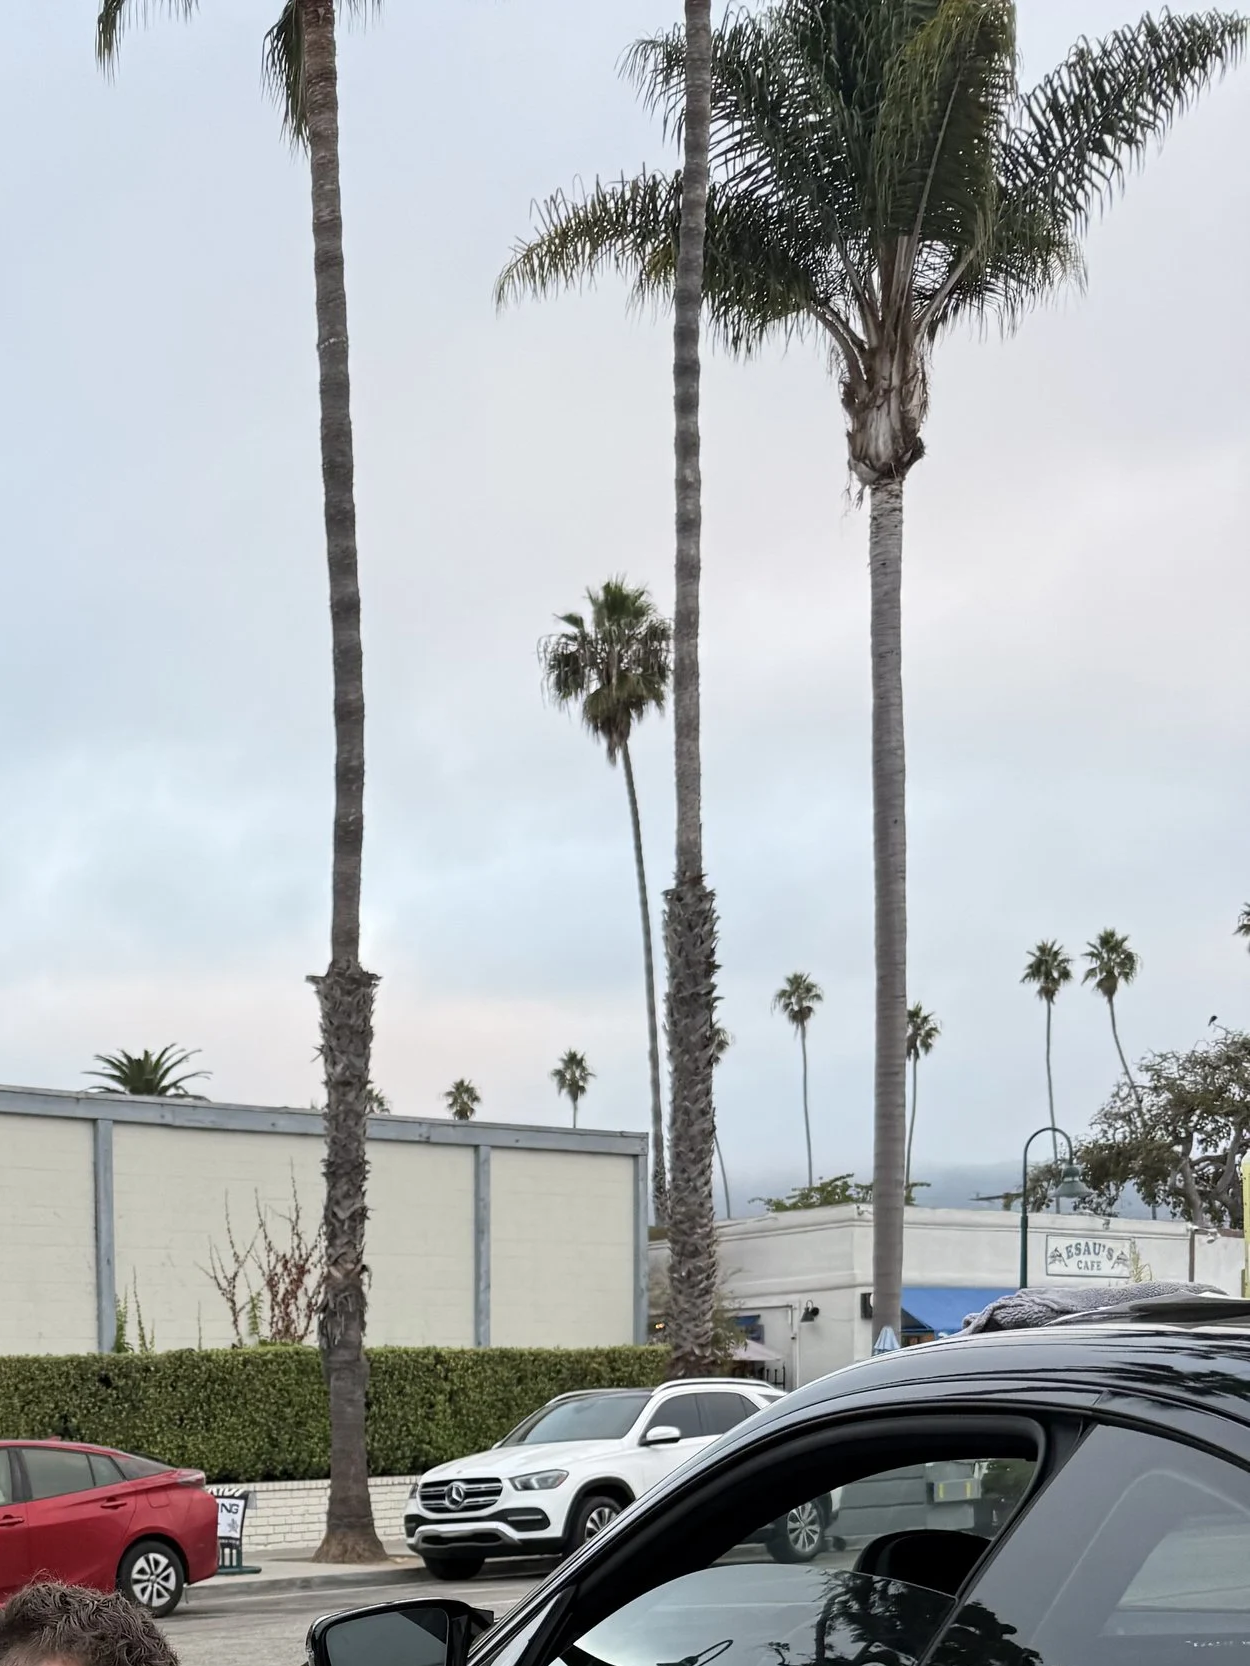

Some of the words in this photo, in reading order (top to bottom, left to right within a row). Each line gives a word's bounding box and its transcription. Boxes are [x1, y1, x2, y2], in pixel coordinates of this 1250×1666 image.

[1065, 1241, 1114, 1261] ESAU'S
[1076, 1260, 1102, 1271] CAFE
[220, 1502, 240, 1515] NG
